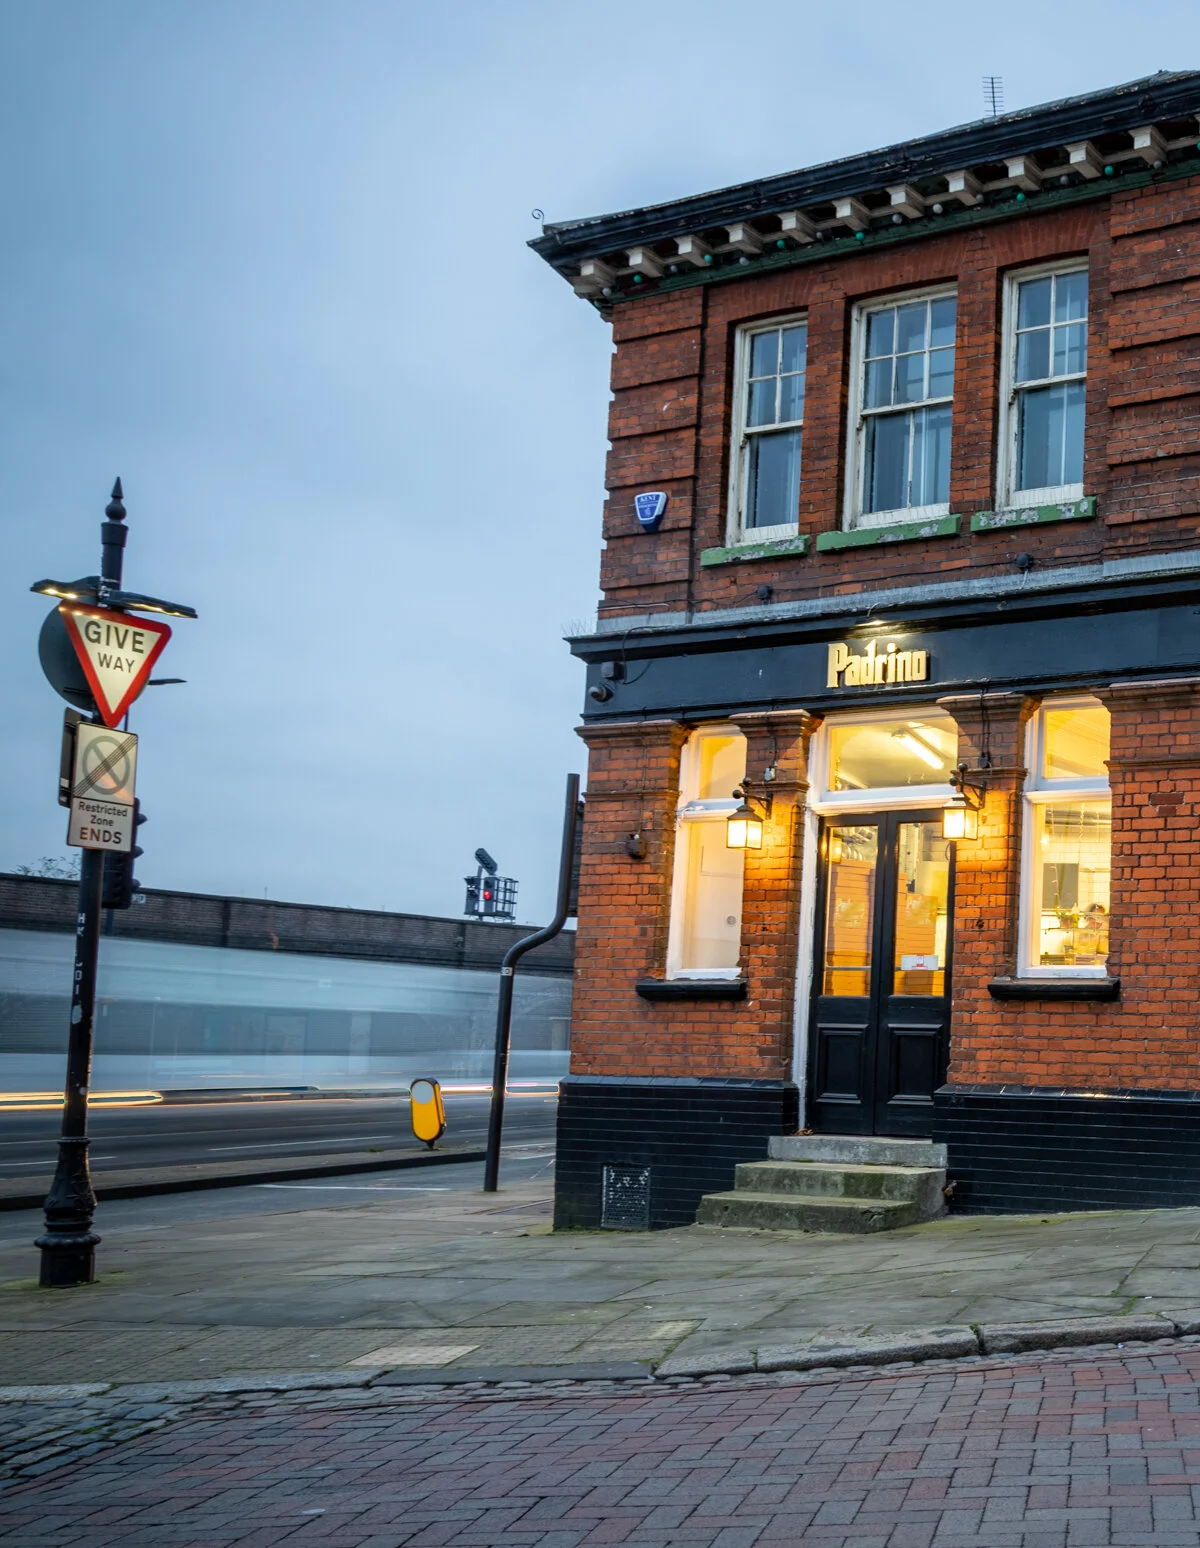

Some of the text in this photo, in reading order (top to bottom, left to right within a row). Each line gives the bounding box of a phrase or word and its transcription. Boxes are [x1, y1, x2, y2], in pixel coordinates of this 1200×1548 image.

[84, 620, 145, 654] GIVE
[97, 652, 135, 673] WAY
[826, 639, 927, 688] Padrino
[78, 801, 128, 817] Restricted
[90, 814, 114, 827] Zone
[79, 827, 122, 845] ENDS
